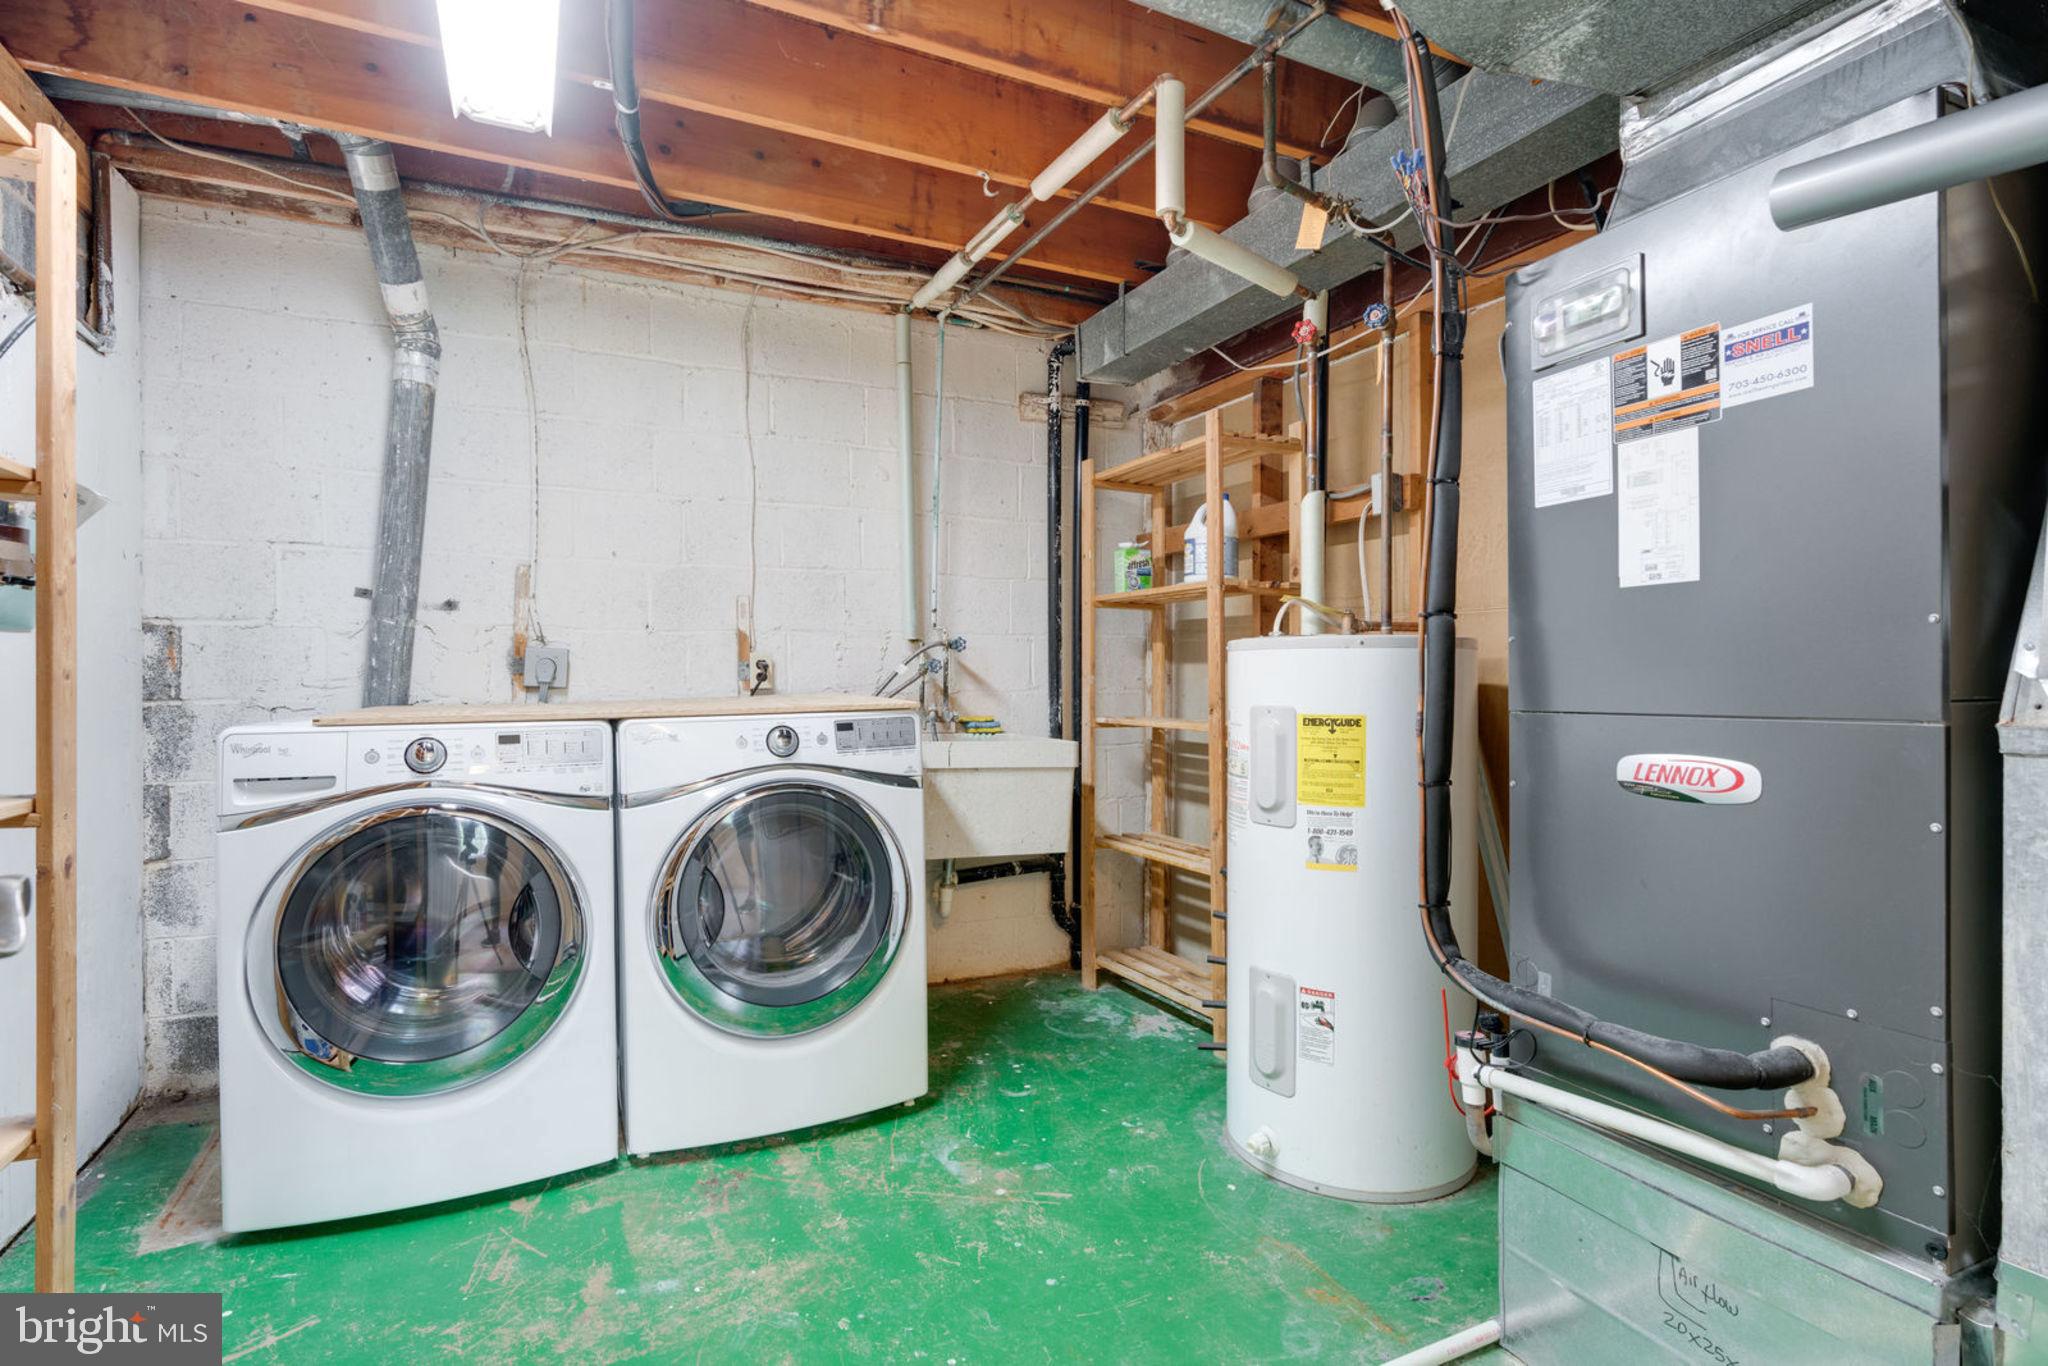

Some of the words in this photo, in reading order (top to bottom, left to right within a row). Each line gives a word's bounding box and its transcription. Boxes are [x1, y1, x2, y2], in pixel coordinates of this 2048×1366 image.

[1731, 327, 1802, 358] SNELL
[1728, 364, 1808, 392] 703-450-6300
[230, 743, 271, 757] Whirlpool
[1632, 762, 1721, 788] LENNOX
[1678, 1265, 1698, 1288] Air
